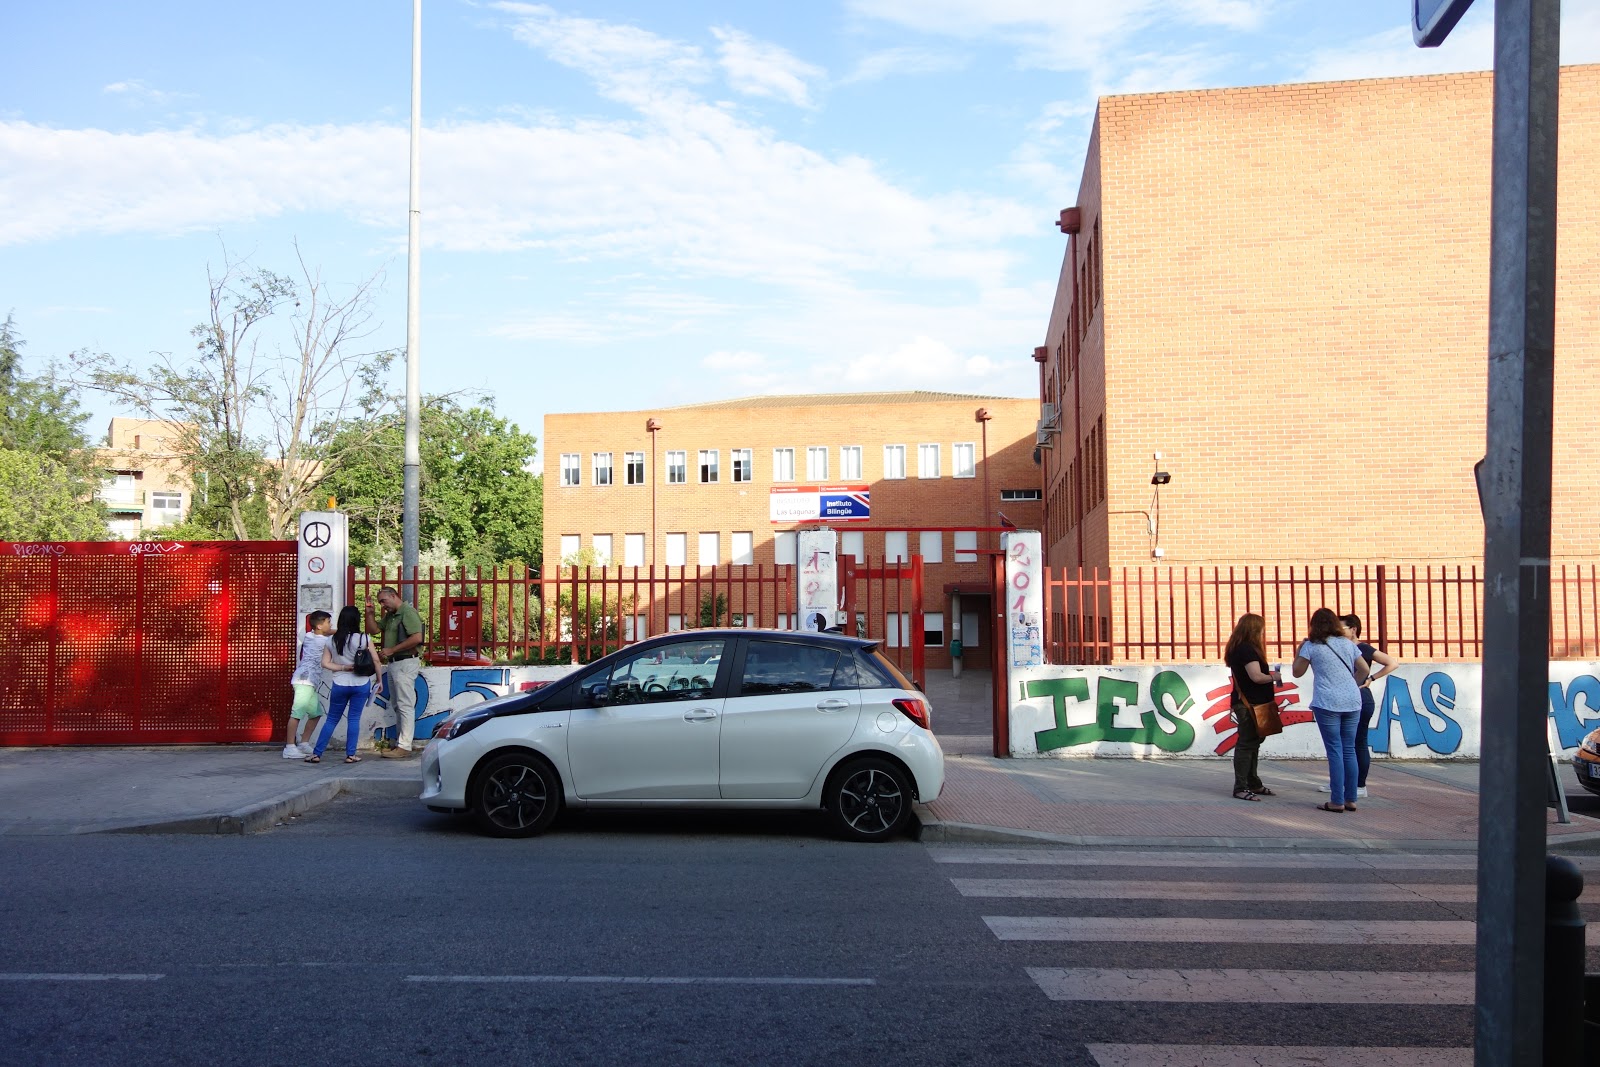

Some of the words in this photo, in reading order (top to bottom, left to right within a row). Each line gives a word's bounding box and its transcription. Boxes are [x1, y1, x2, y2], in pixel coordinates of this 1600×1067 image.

[776, 508, 788, 516] Las
[789, 509, 816, 517] Lagunas
[826, 508, 852, 516] Bilingüe
[1021, 670, 1196, 752] IES
[1367, 672, 1463, 754] AS
